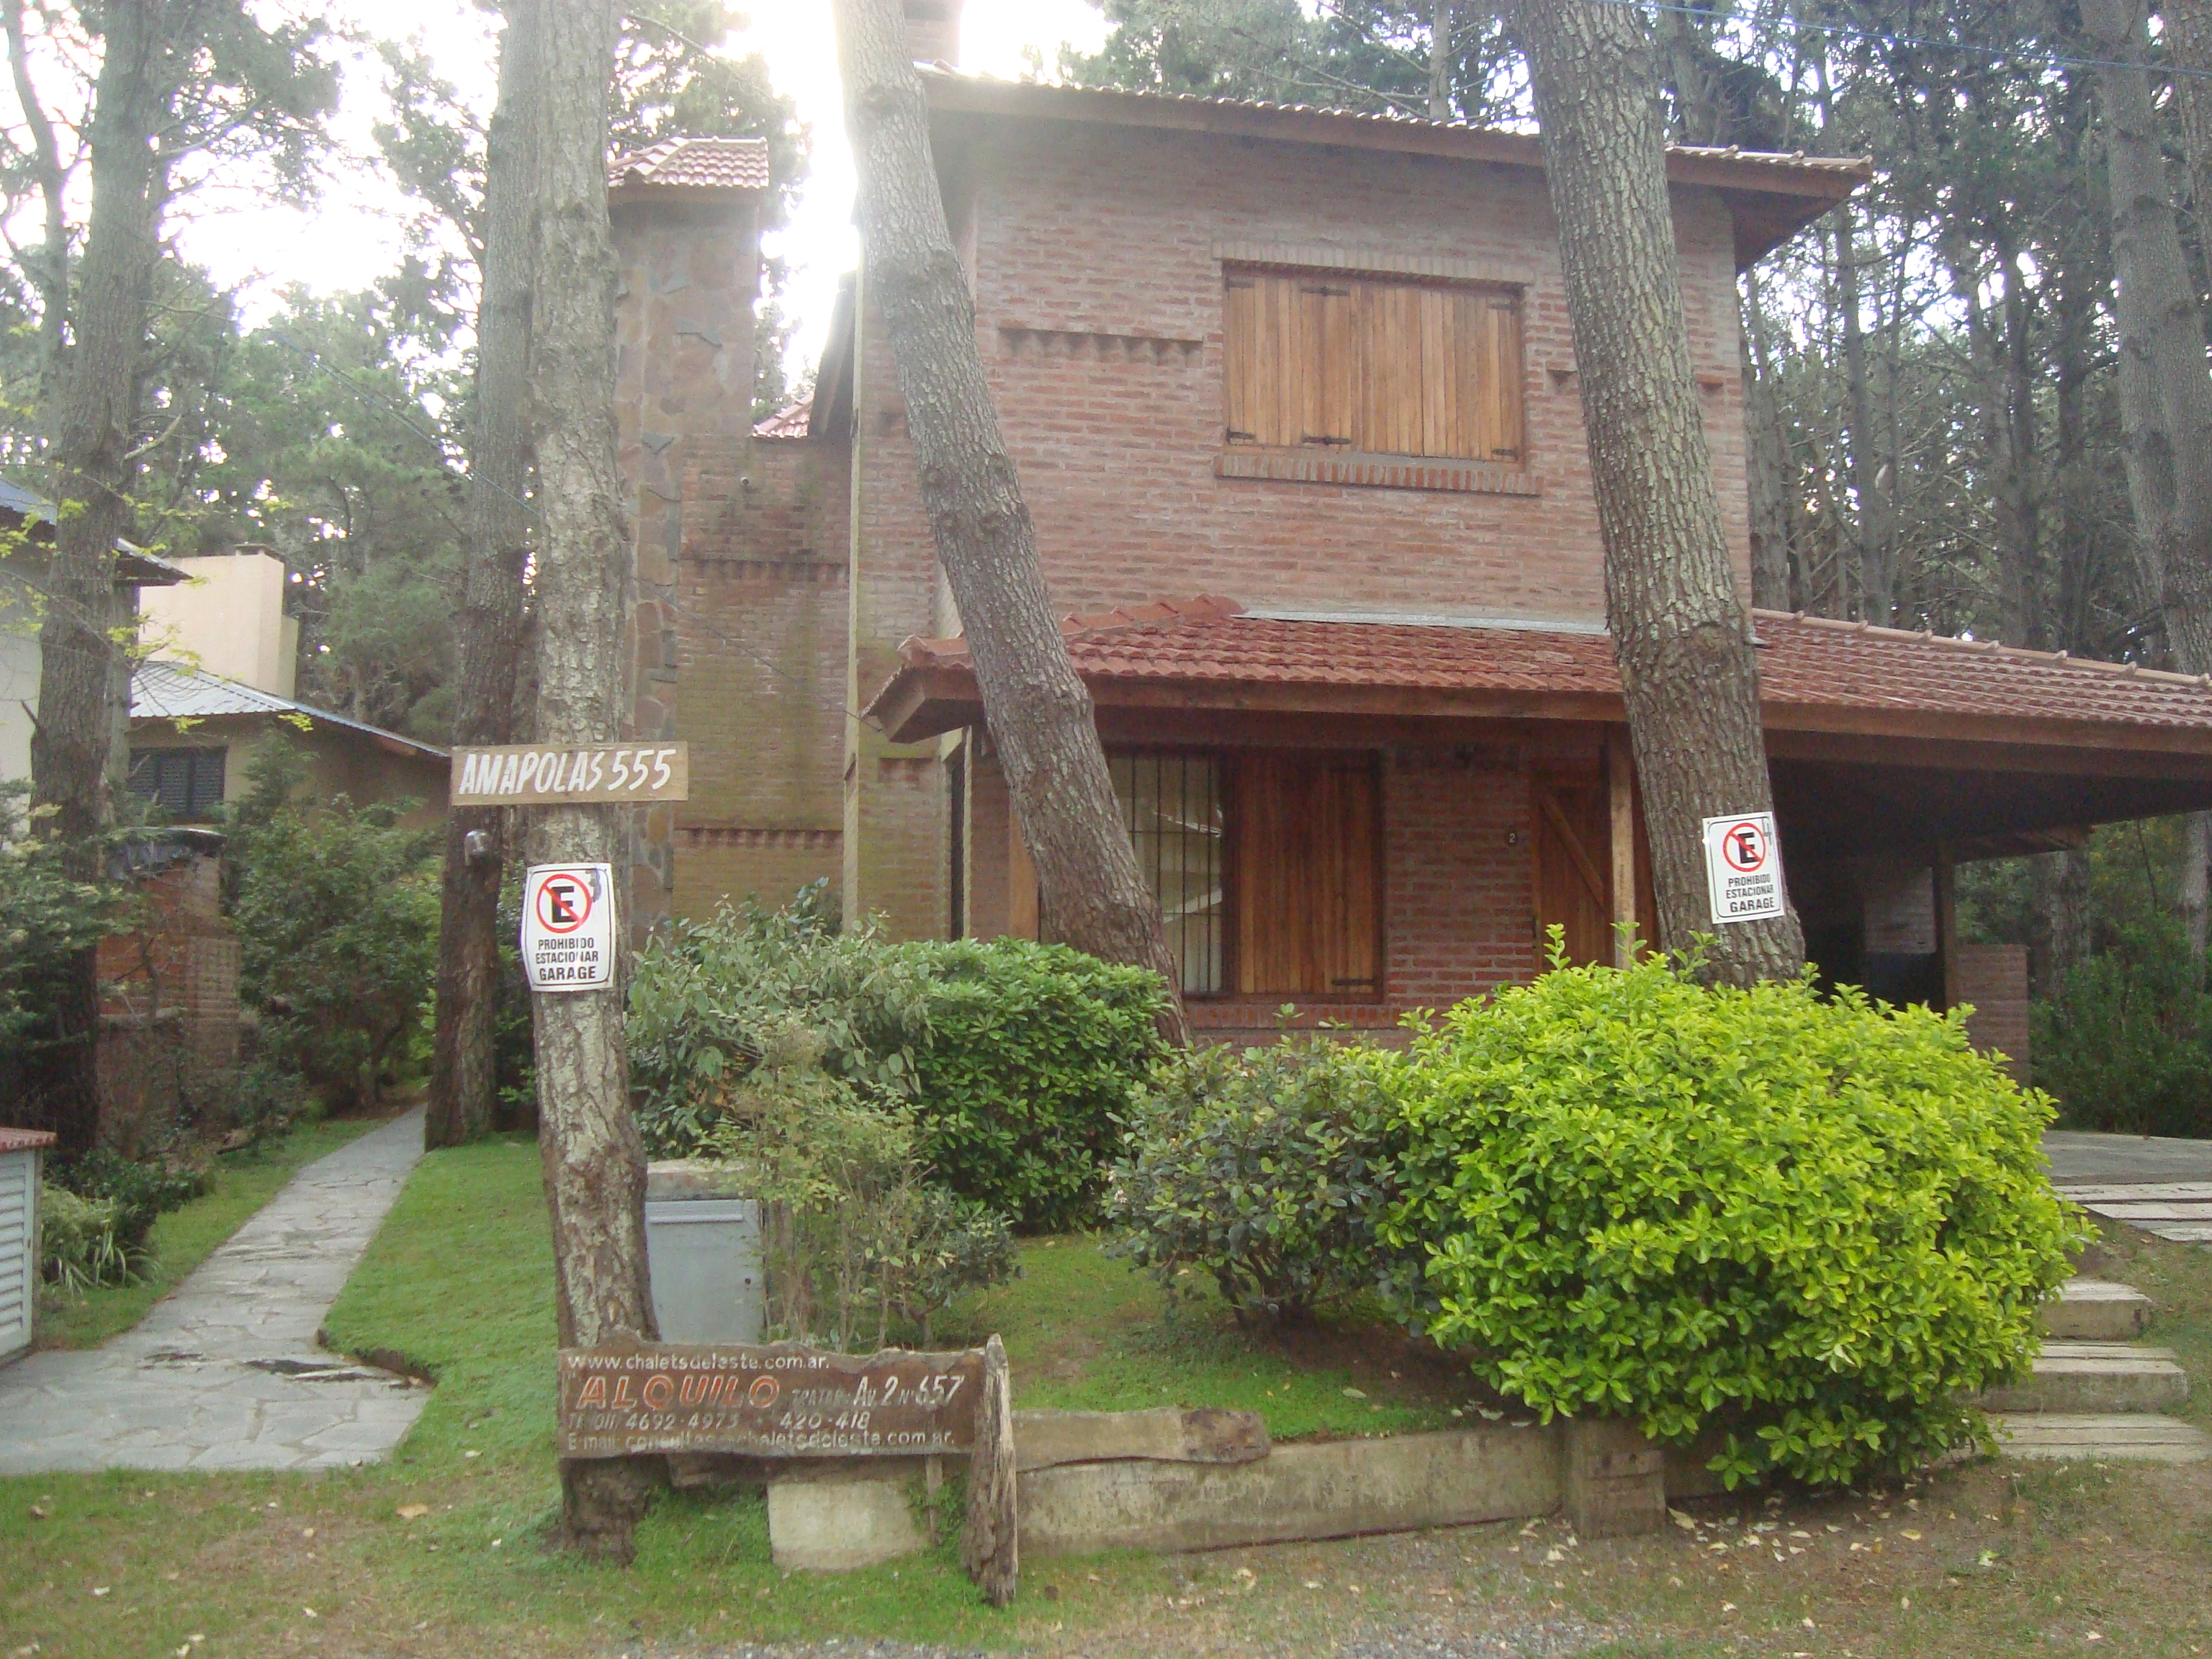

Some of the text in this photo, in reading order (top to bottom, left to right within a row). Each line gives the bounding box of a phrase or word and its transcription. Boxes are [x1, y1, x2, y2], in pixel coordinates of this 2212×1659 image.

[459, 749, 676, 795] AMAPOLAS 555
[1509, 832, 1516, 843] 2
[1728, 873, 1771, 887] PROHIBIDO
[1726, 884, 1774, 899] ESTACIONAR
[1730, 897, 1775, 913] GARAGE
[538, 938, 594, 950] PROHIBIDO
[539, 966, 596, 981] GARAGE
[576, 1374, 780, 1411] ALQUILO
[880, 1375, 899, 1406] 2
[915, 1375, 966, 1406] 657
